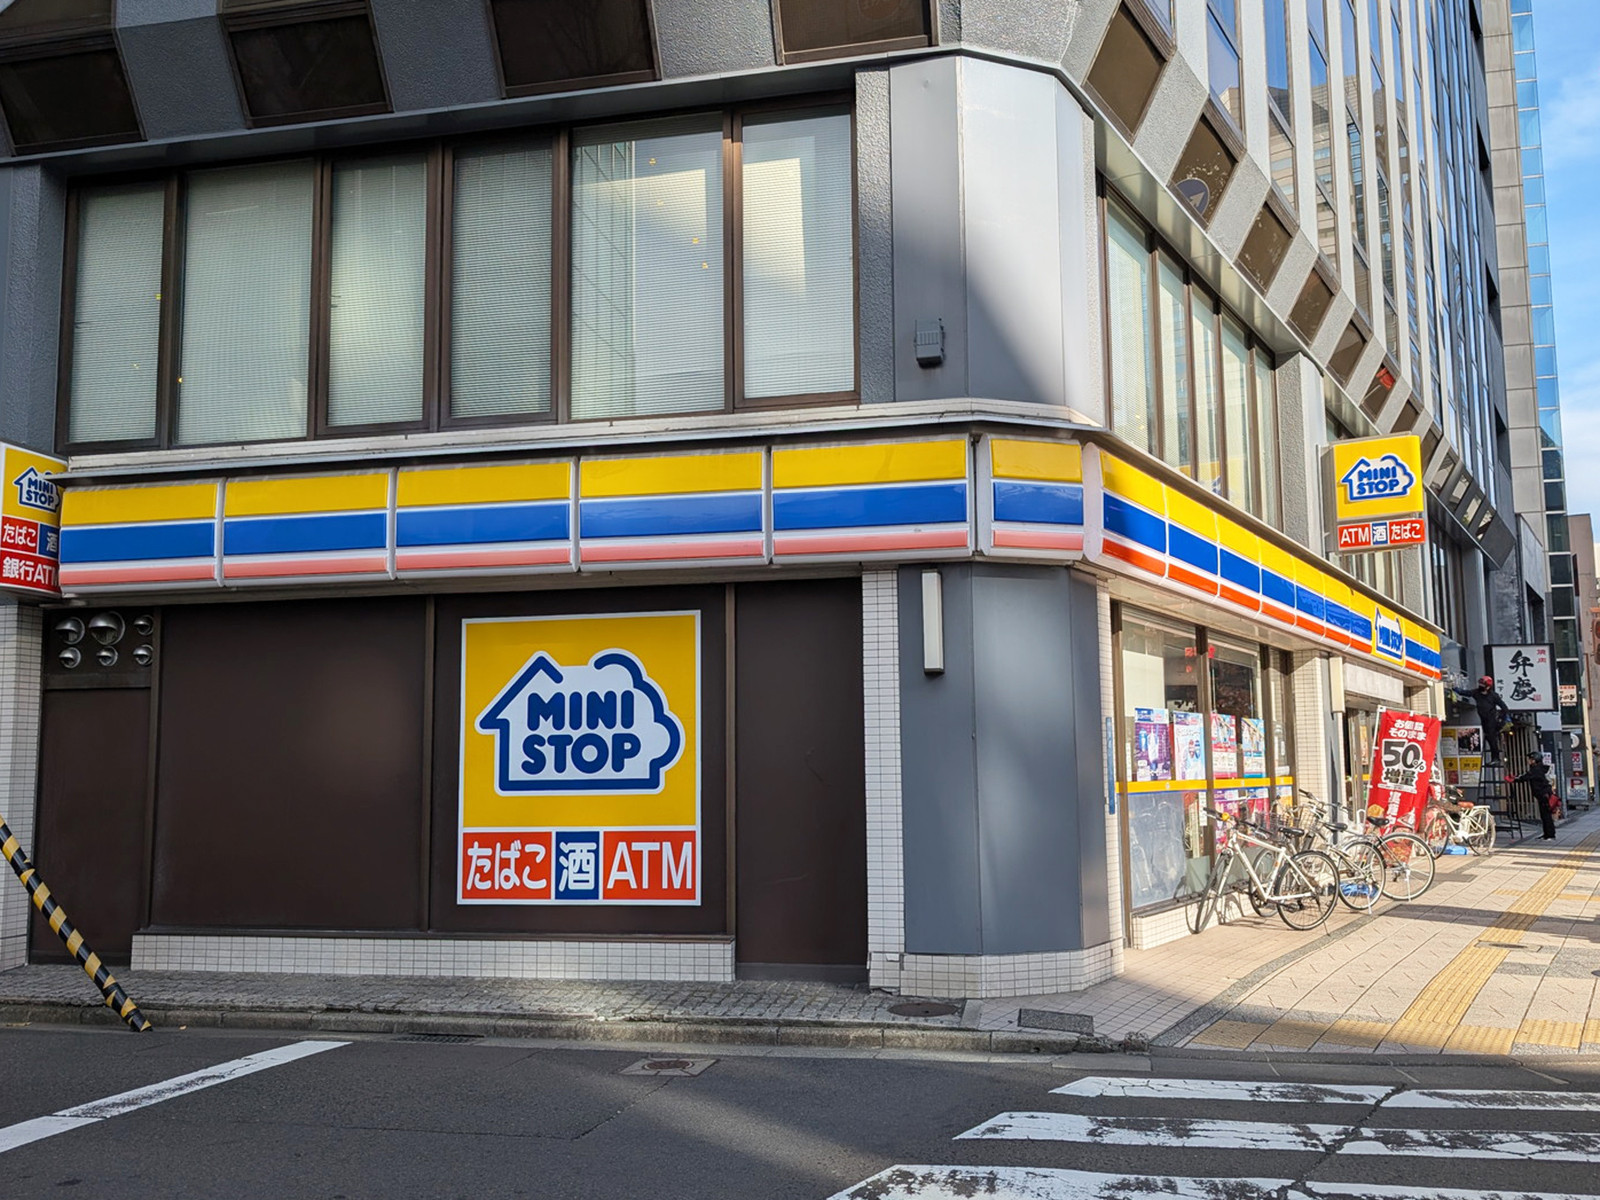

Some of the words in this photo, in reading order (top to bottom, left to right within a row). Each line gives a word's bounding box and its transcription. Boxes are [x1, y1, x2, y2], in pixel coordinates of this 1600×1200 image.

[1357, 466, 1398, 482] MINI
[27, 477, 54, 495] MINI
[1357, 479, 1400, 495] STOP
[25, 489, 55, 507] STOP
[2, 523, 37, 547] たばこ
[46, 531, 58, 553] 酒
[1340, 527, 1370, 545] ATM
[1373, 525, 1387, 543] 酒
[1391, 522, 1421, 540] たばこ
[527, 690, 635, 731] MINI
[521, 732, 642, 775] STOP
[1383, 740, 1425, 771] 50%
[1570, 779, 1584, 789] P
[467, 839, 547, 890] たばこ
[559, 841, 597, 892] 酒
[607, 841, 693, 890] ATM
